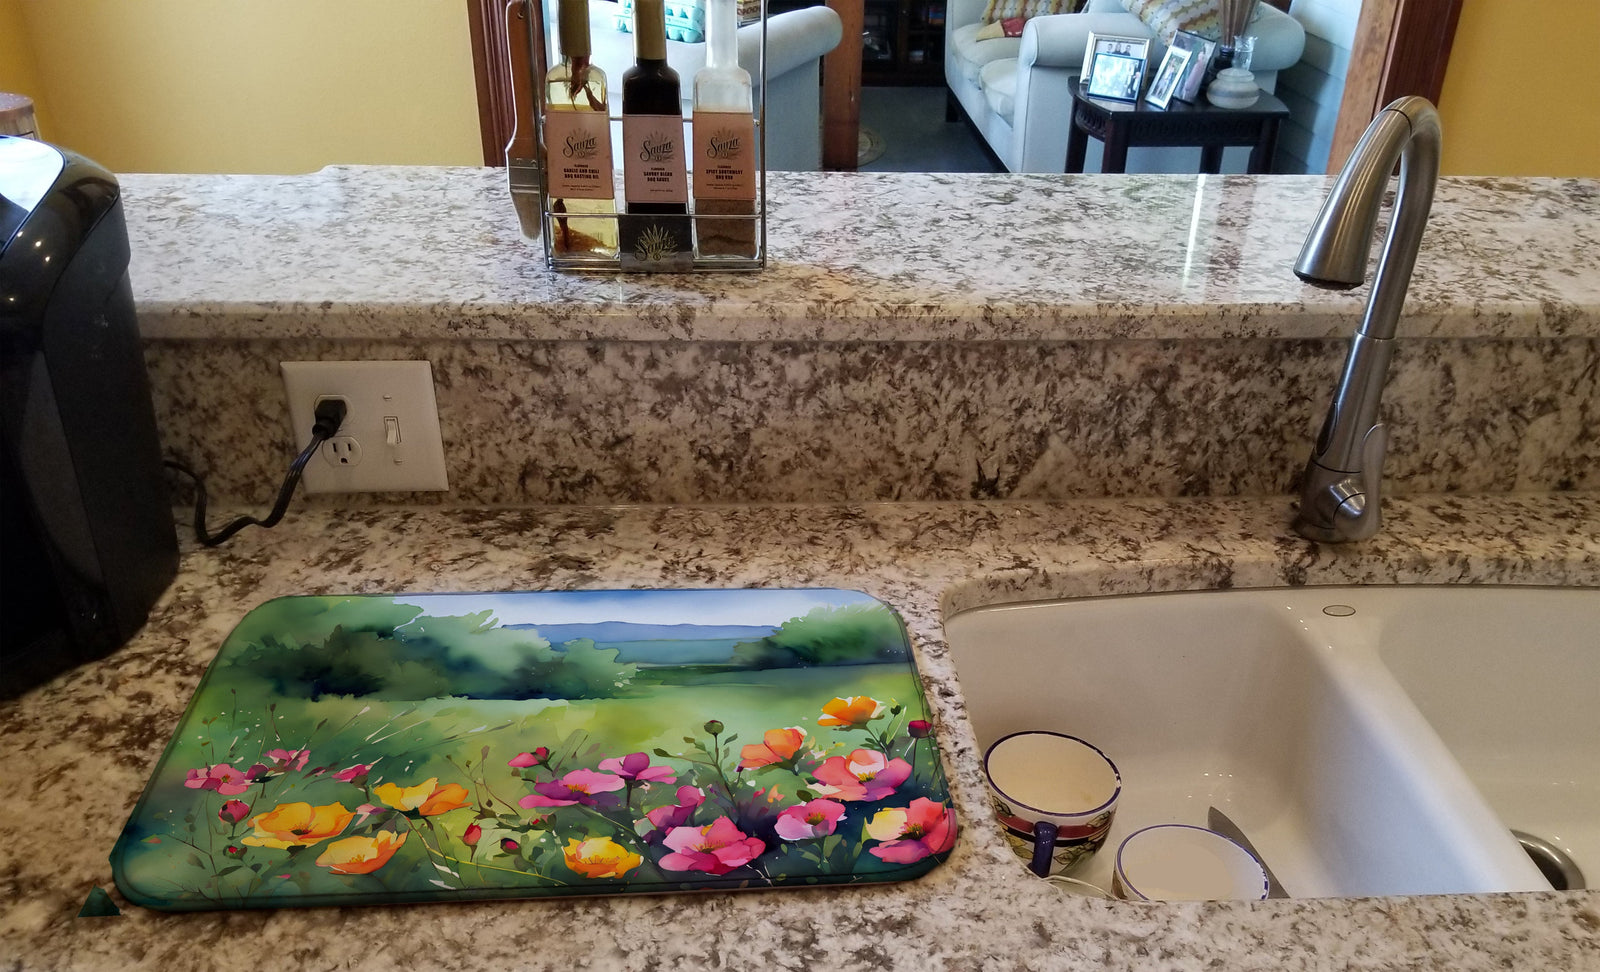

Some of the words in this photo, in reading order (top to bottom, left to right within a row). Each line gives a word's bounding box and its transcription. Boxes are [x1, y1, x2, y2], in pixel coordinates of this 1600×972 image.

[563, 136, 597, 158] Sauza
[640, 140, 673, 161] Sauza
[707, 137, 740, 158] Sauza
